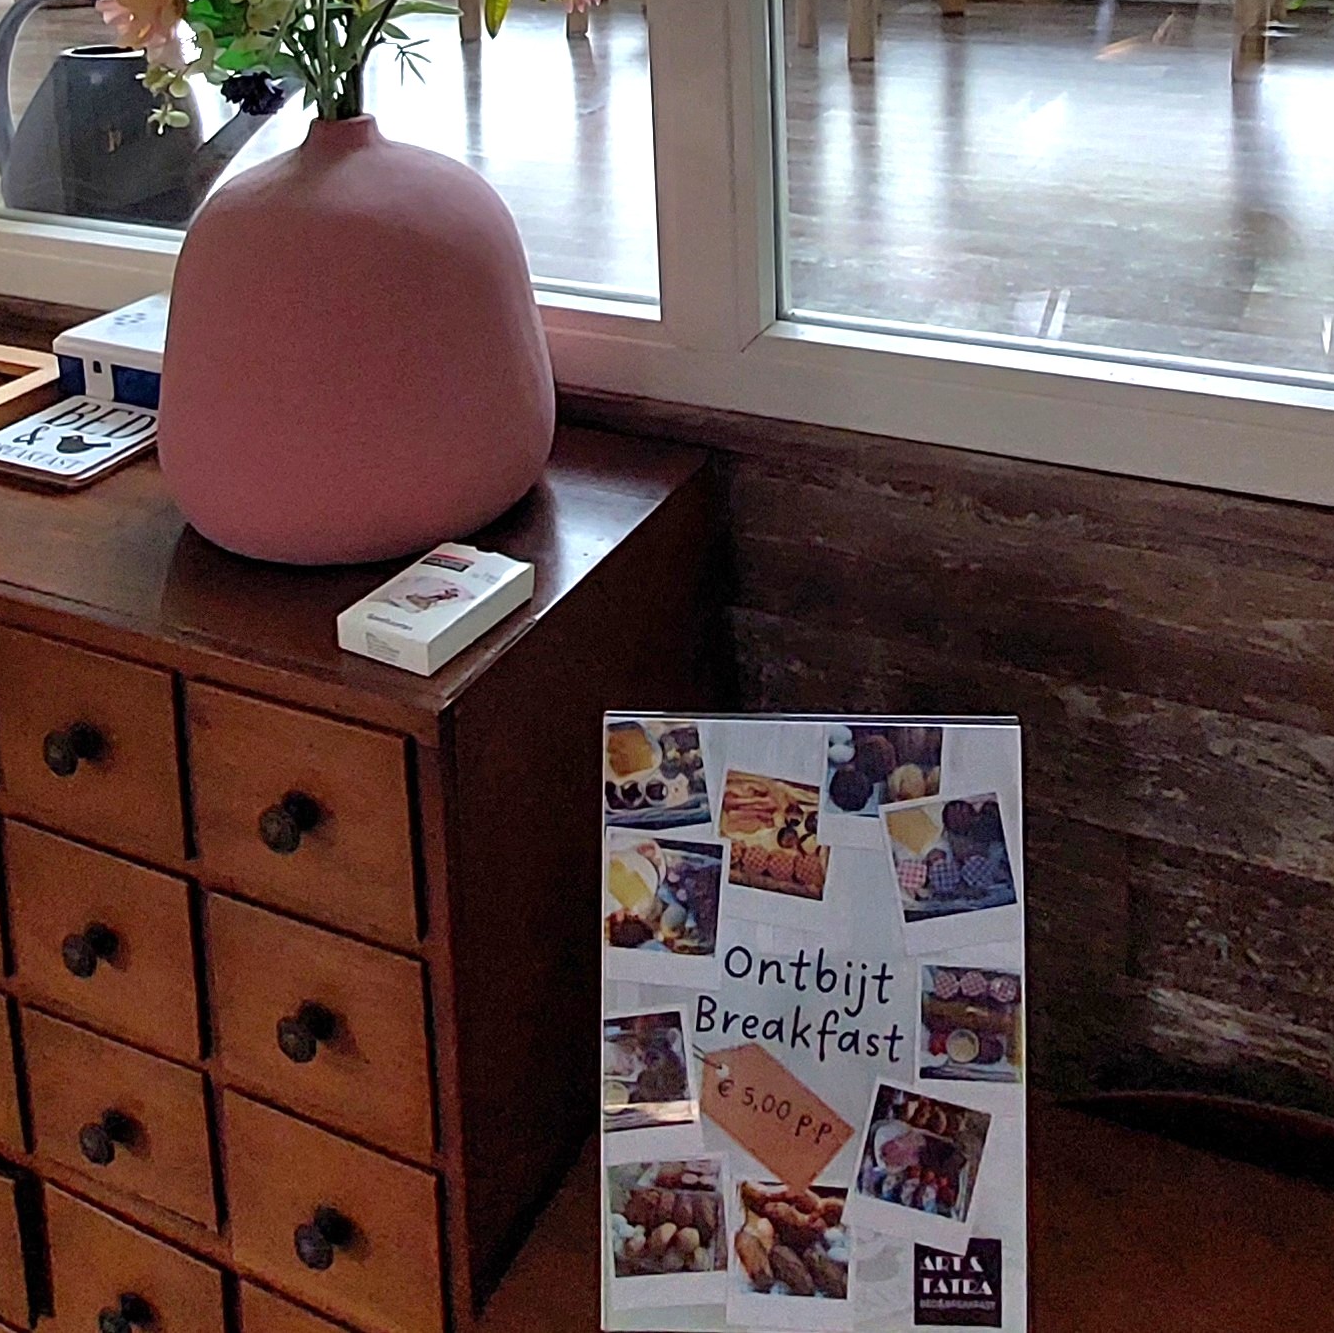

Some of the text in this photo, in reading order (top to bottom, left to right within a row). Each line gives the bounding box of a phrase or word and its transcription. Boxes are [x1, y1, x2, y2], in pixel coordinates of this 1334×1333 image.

[42, 402, 156, 439] BED
[12, 426, 51, 446] &
[724, 946, 895, 1017] Ontbijt
[695, 996, 905, 1063] Breakfast
[718, 1078, 735, 1098] €
[920, 1256, 962, 1272] ART
[921, 1278, 993, 1295] TATRA
